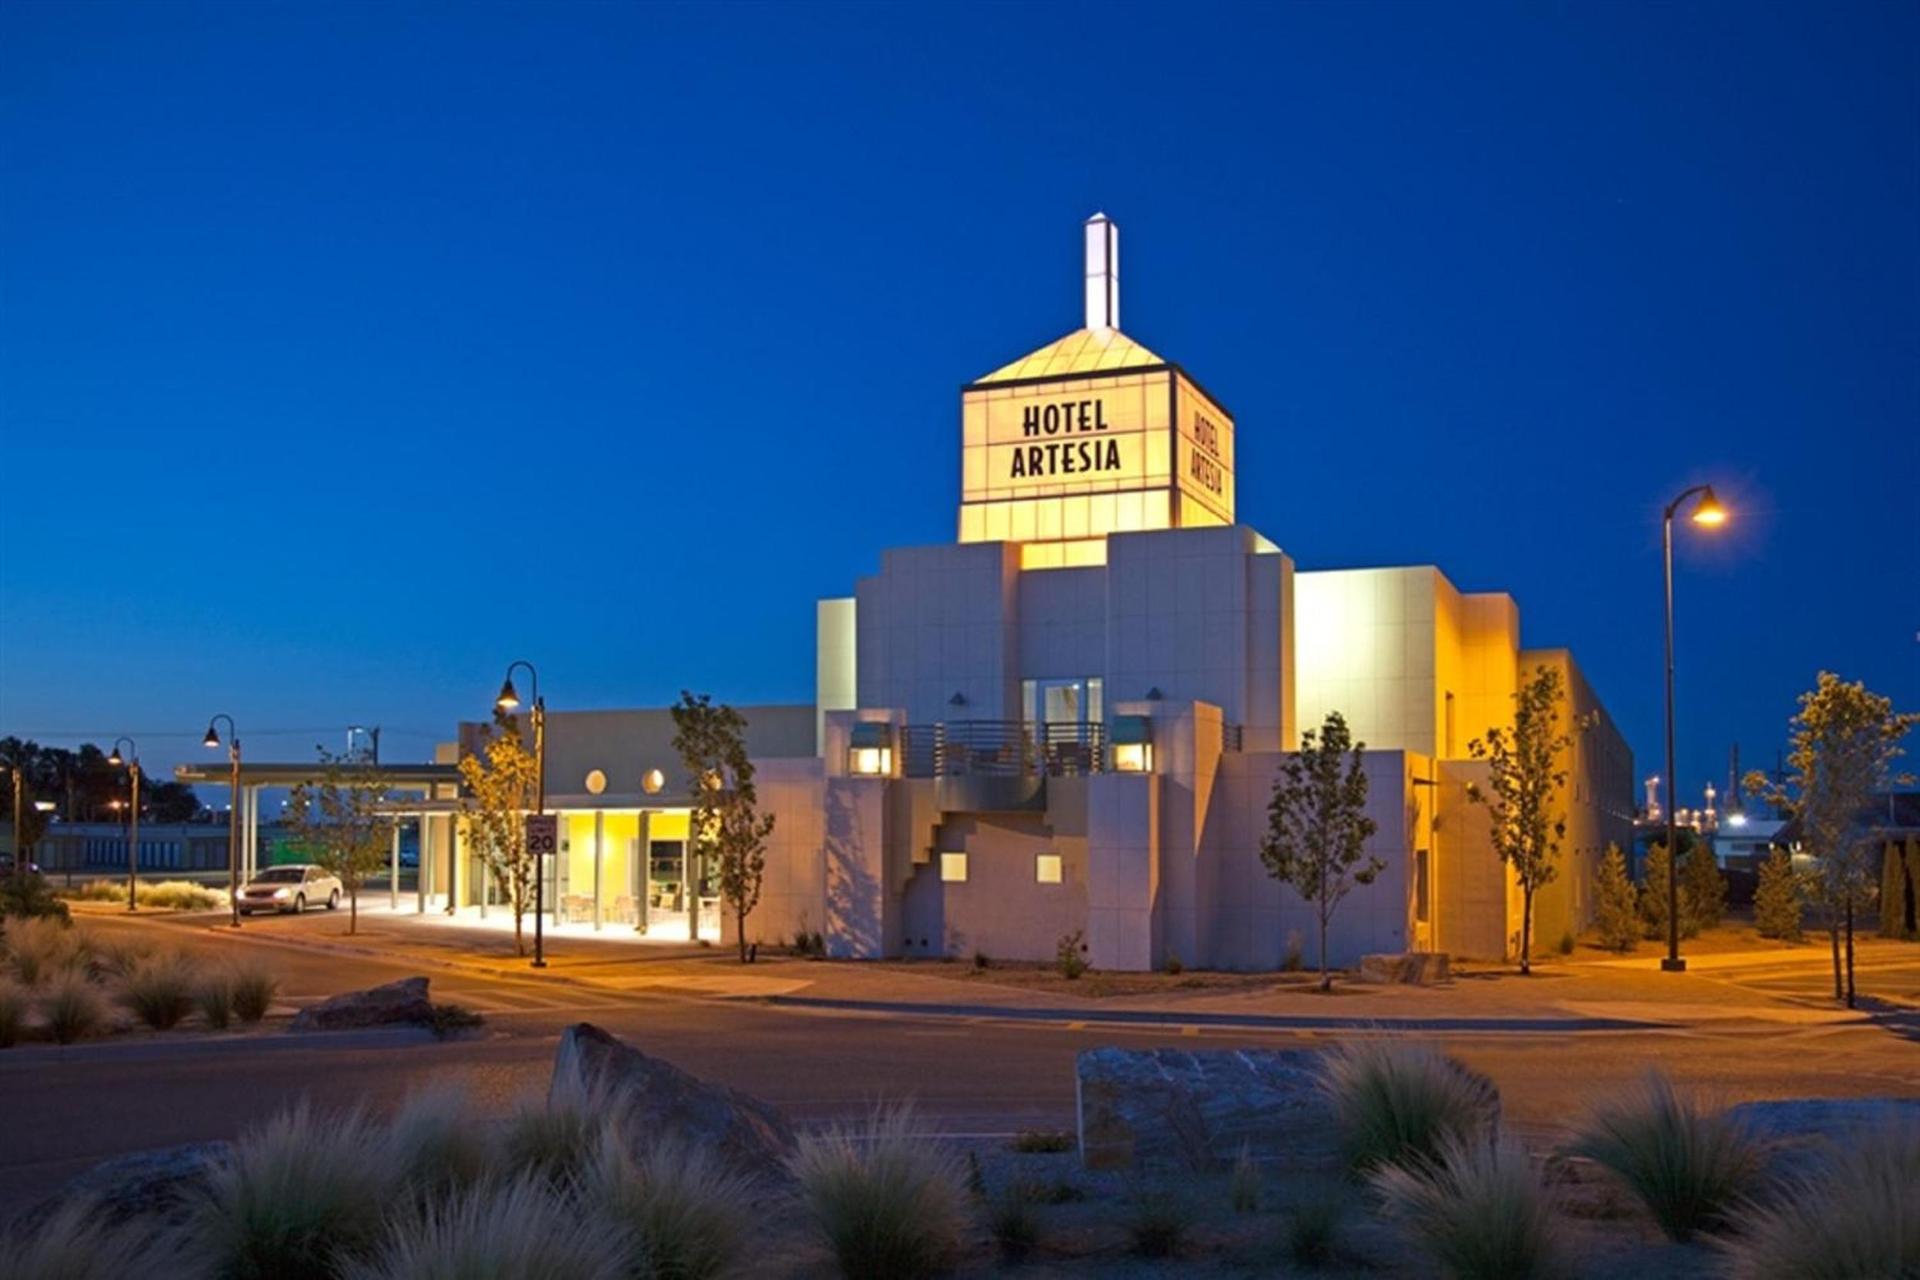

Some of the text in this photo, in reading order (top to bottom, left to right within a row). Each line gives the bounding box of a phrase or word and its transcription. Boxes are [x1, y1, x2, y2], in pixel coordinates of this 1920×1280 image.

[1023, 399, 1107, 437] HOTEL
[1194, 411, 1219, 457] HOTEL
[1011, 439, 1120, 478] ARTESIA
[1191, 448, 1222, 495] ARTESIA
[530, 835, 553, 850] 20
